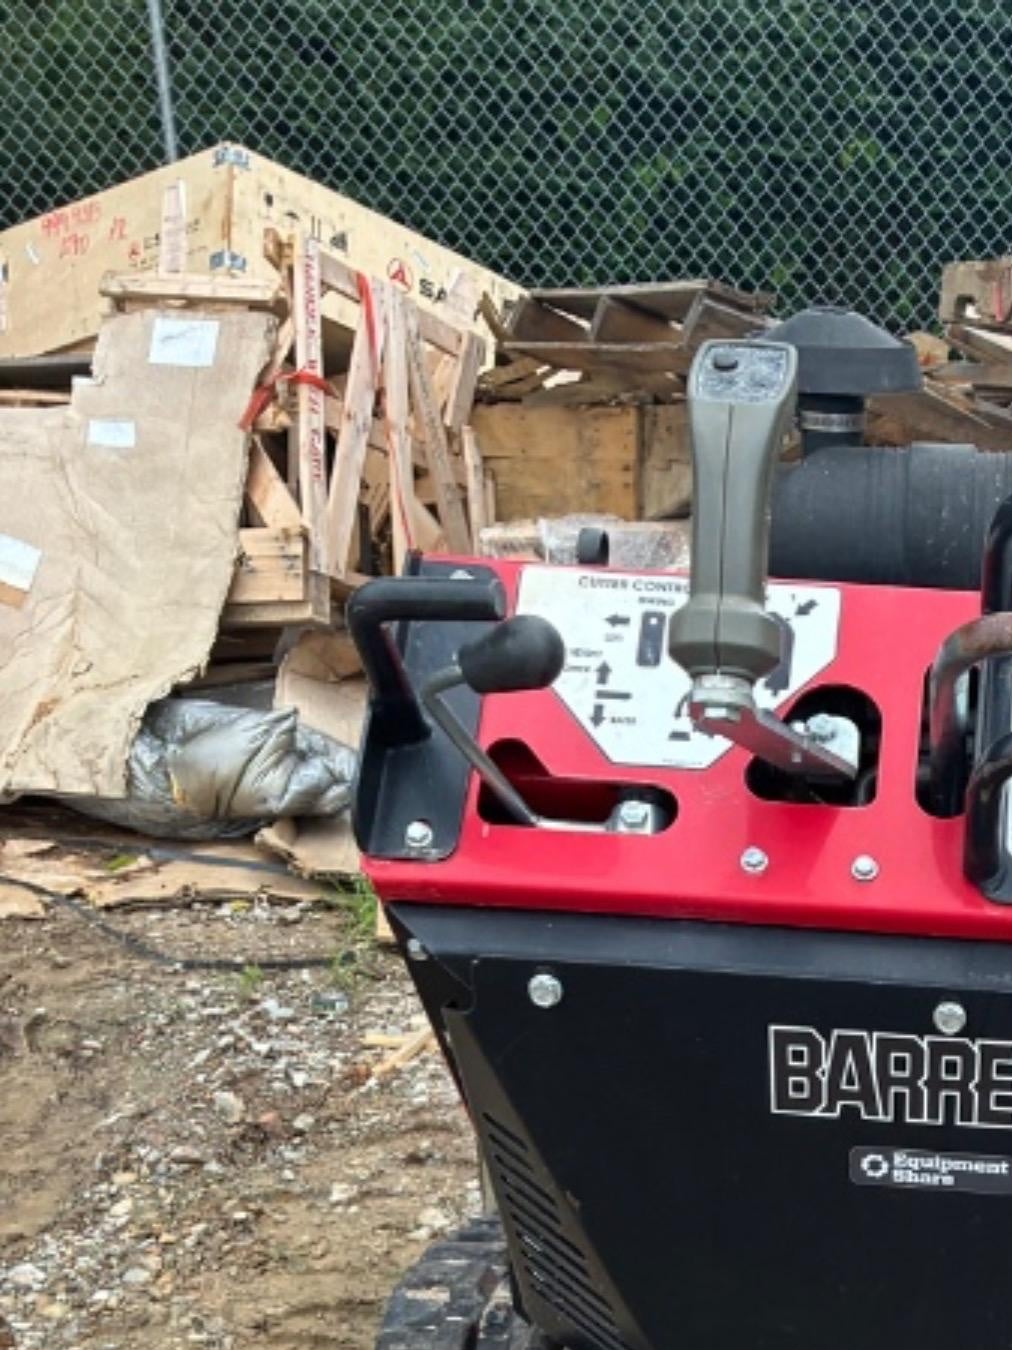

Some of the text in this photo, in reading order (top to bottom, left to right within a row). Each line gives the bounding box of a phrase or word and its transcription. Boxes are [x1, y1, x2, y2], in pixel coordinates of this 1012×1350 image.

[632, 578, 691, 593] CONTRO
[892, 1151, 1010, 1176] Equipment
[892, 1168, 956, 1187] Share
